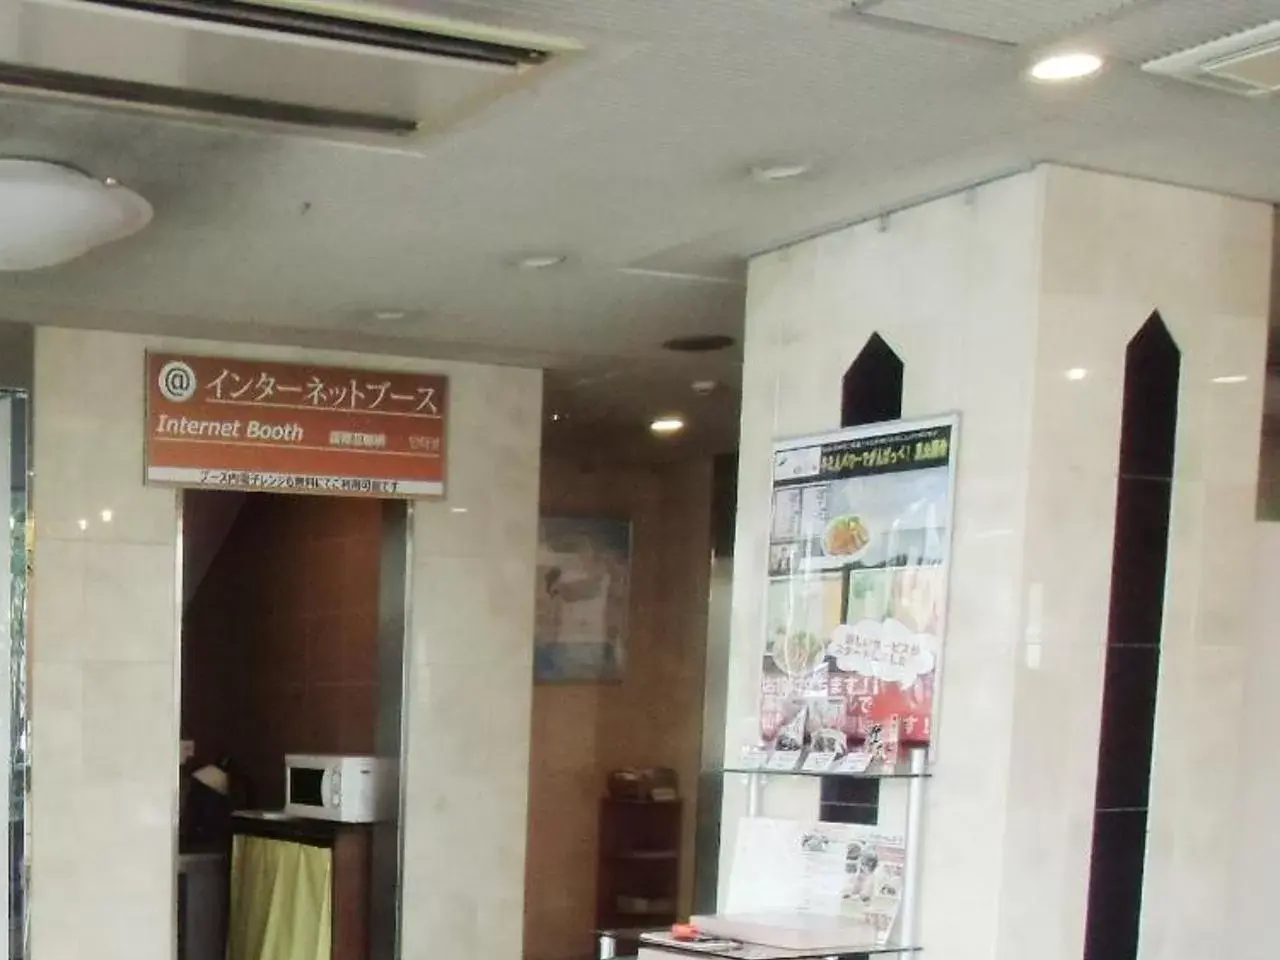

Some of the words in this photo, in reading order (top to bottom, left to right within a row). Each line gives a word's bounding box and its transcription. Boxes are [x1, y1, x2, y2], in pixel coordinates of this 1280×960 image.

[204, 369, 438, 415] インターネットブース
[156, 414, 241, 438] Internet
[247, 420, 304, 443] Booth
